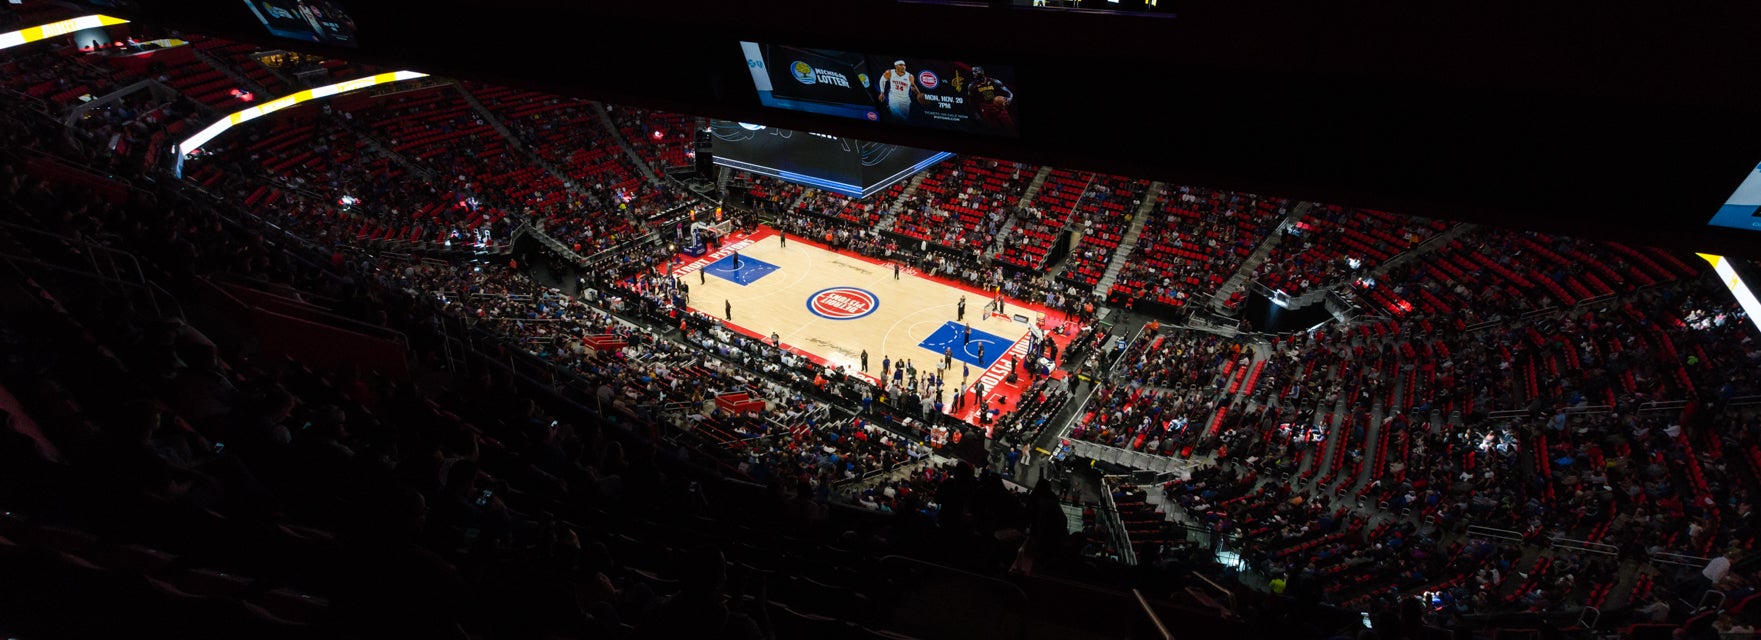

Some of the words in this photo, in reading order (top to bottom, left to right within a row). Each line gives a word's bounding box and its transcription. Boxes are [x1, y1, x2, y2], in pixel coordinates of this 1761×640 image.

[817, 75, 850, 88] LOTTERY
[941, 95, 955, 103] NOV.
[708, 238, 755, 259] PISTONS
[819, 297, 858, 313] DETROIT
[827, 293, 866, 309] PISTONS
